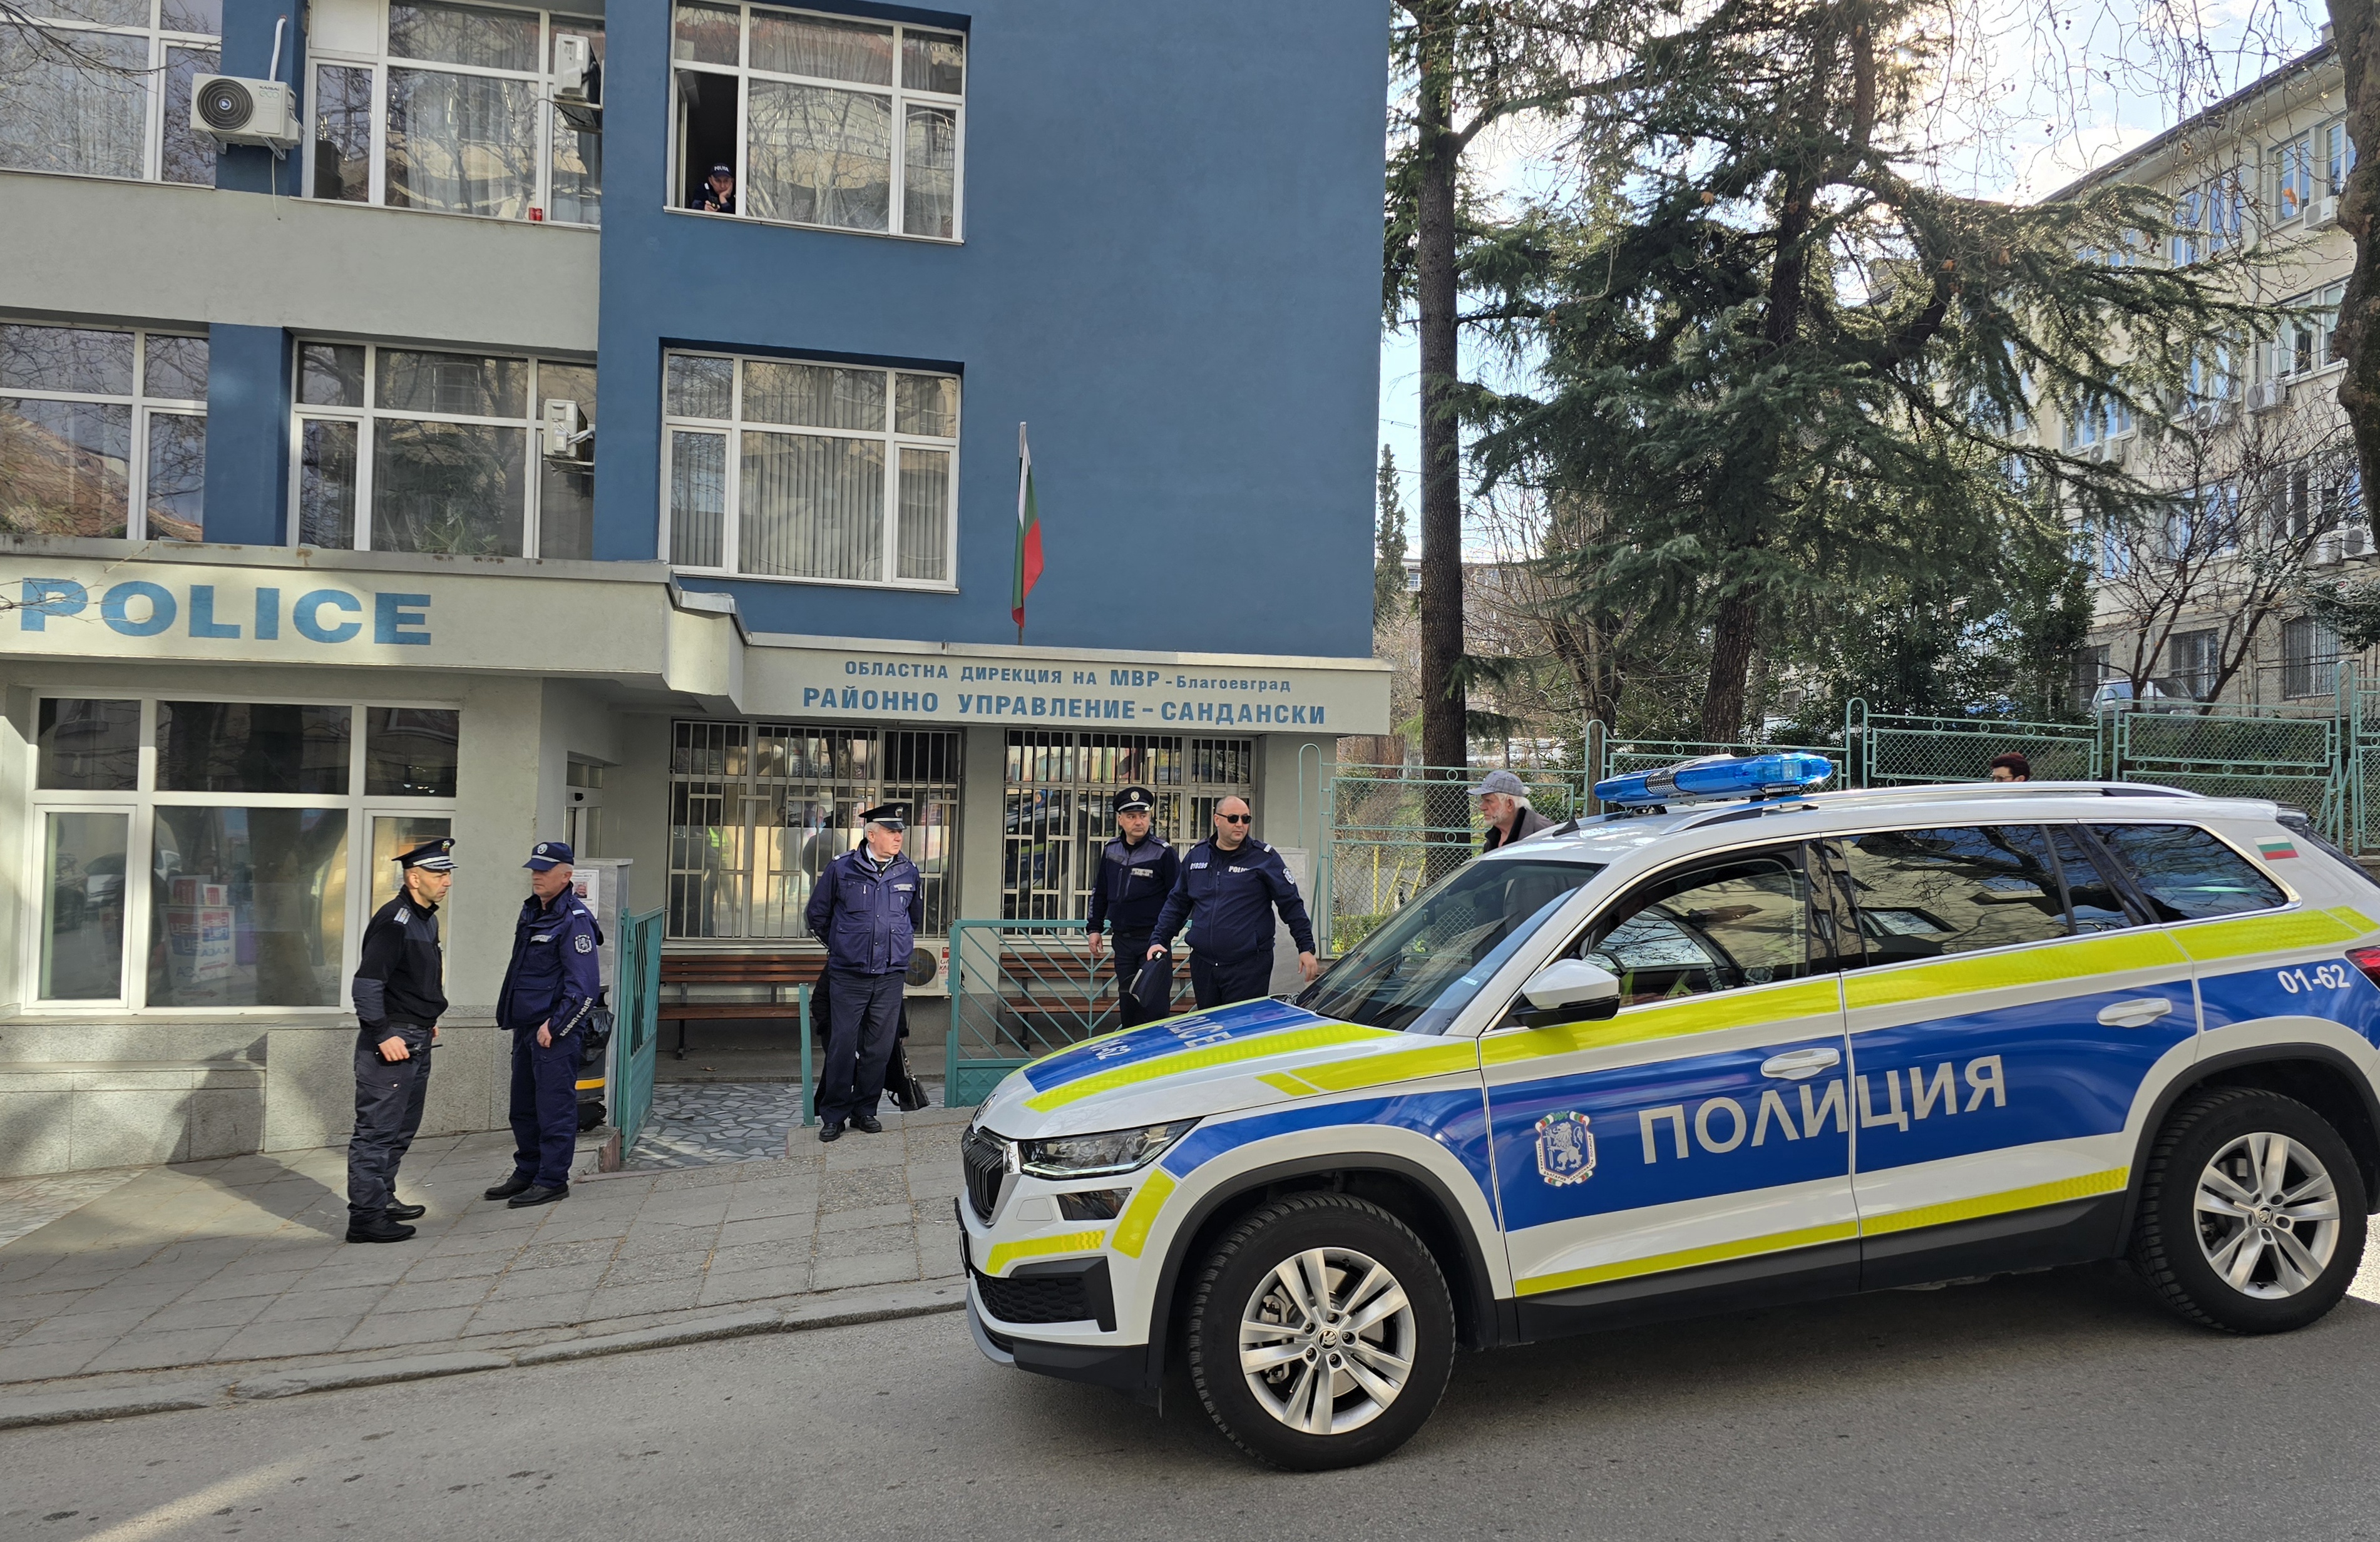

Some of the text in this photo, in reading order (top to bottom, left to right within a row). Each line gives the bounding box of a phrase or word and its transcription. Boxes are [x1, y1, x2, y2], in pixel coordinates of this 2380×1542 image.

[21, 578, 431, 645] POLICE
[845, 661, 948, 679] ОБЛАСТНА
[961, 666, 1062, 685] ДИРЕКЦИЯ
[1073, 671, 1097, 685] НА
[803, 685, 938, 713] РАЙОННО
[2277, 964, 2351, 994] 01-62
[1158, 1016, 1233, 1048] OLICE
[1638, 1054, 2006, 1165] ПОЛИЦИЯ
